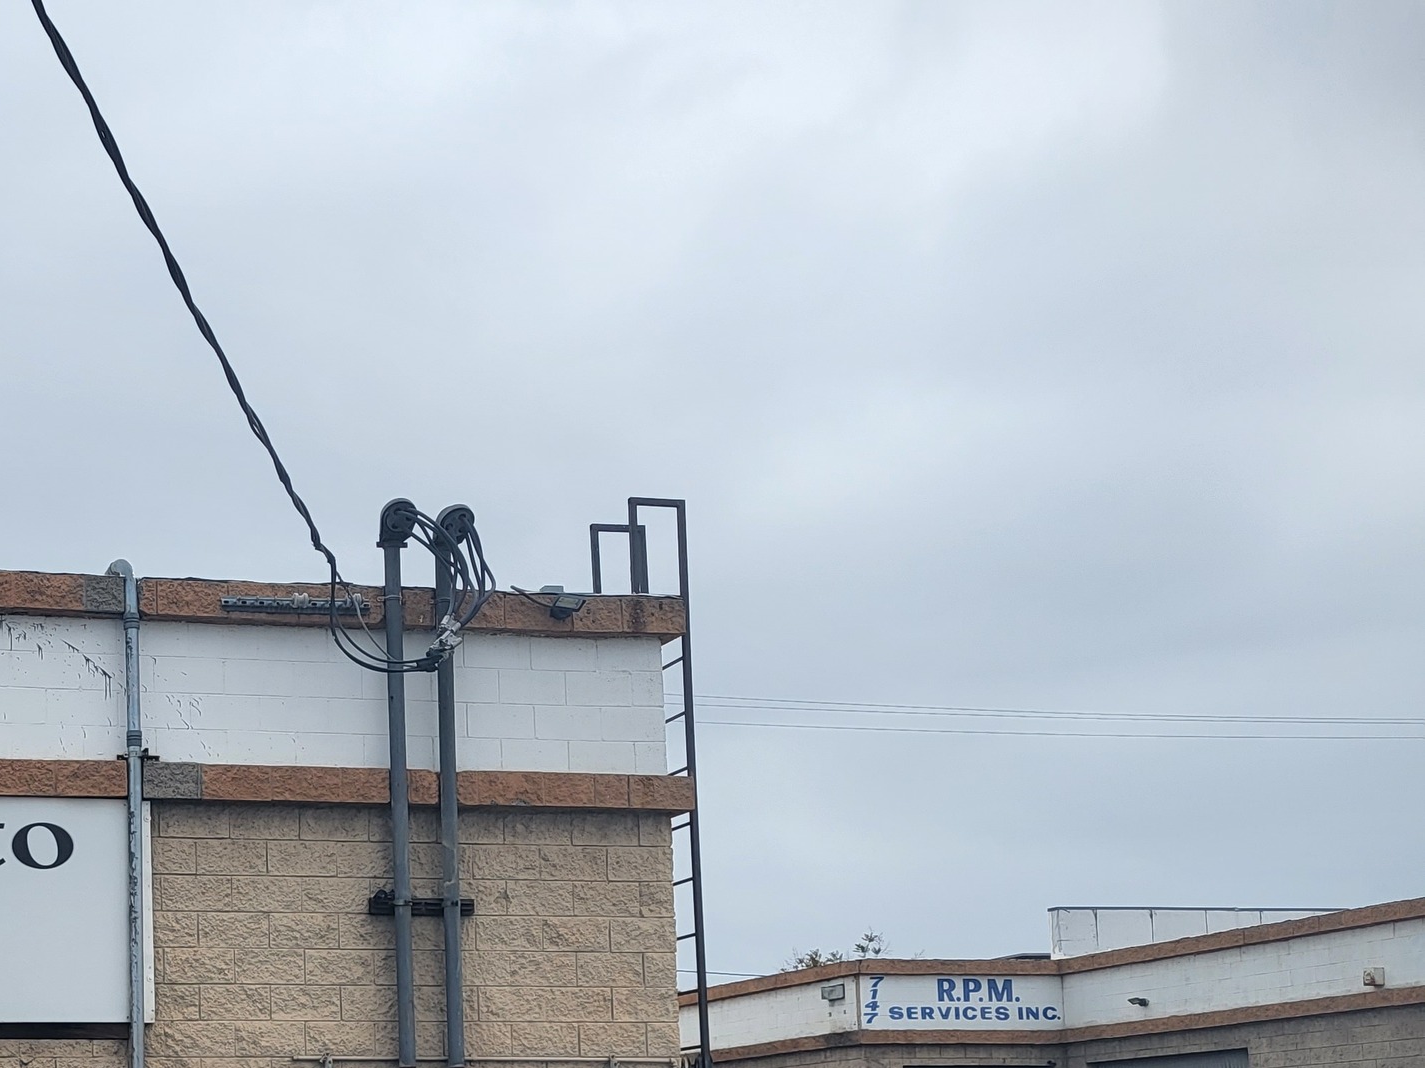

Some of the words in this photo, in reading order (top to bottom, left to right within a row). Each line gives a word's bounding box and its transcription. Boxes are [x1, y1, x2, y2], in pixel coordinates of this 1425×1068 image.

[864, 977, 884, 1024] 7147
[936, 978, 1020, 1002] R.P.M.
[888, 1006, 1010, 1021] SERVICES
[1017, 1006, 1061, 1021] INC.
